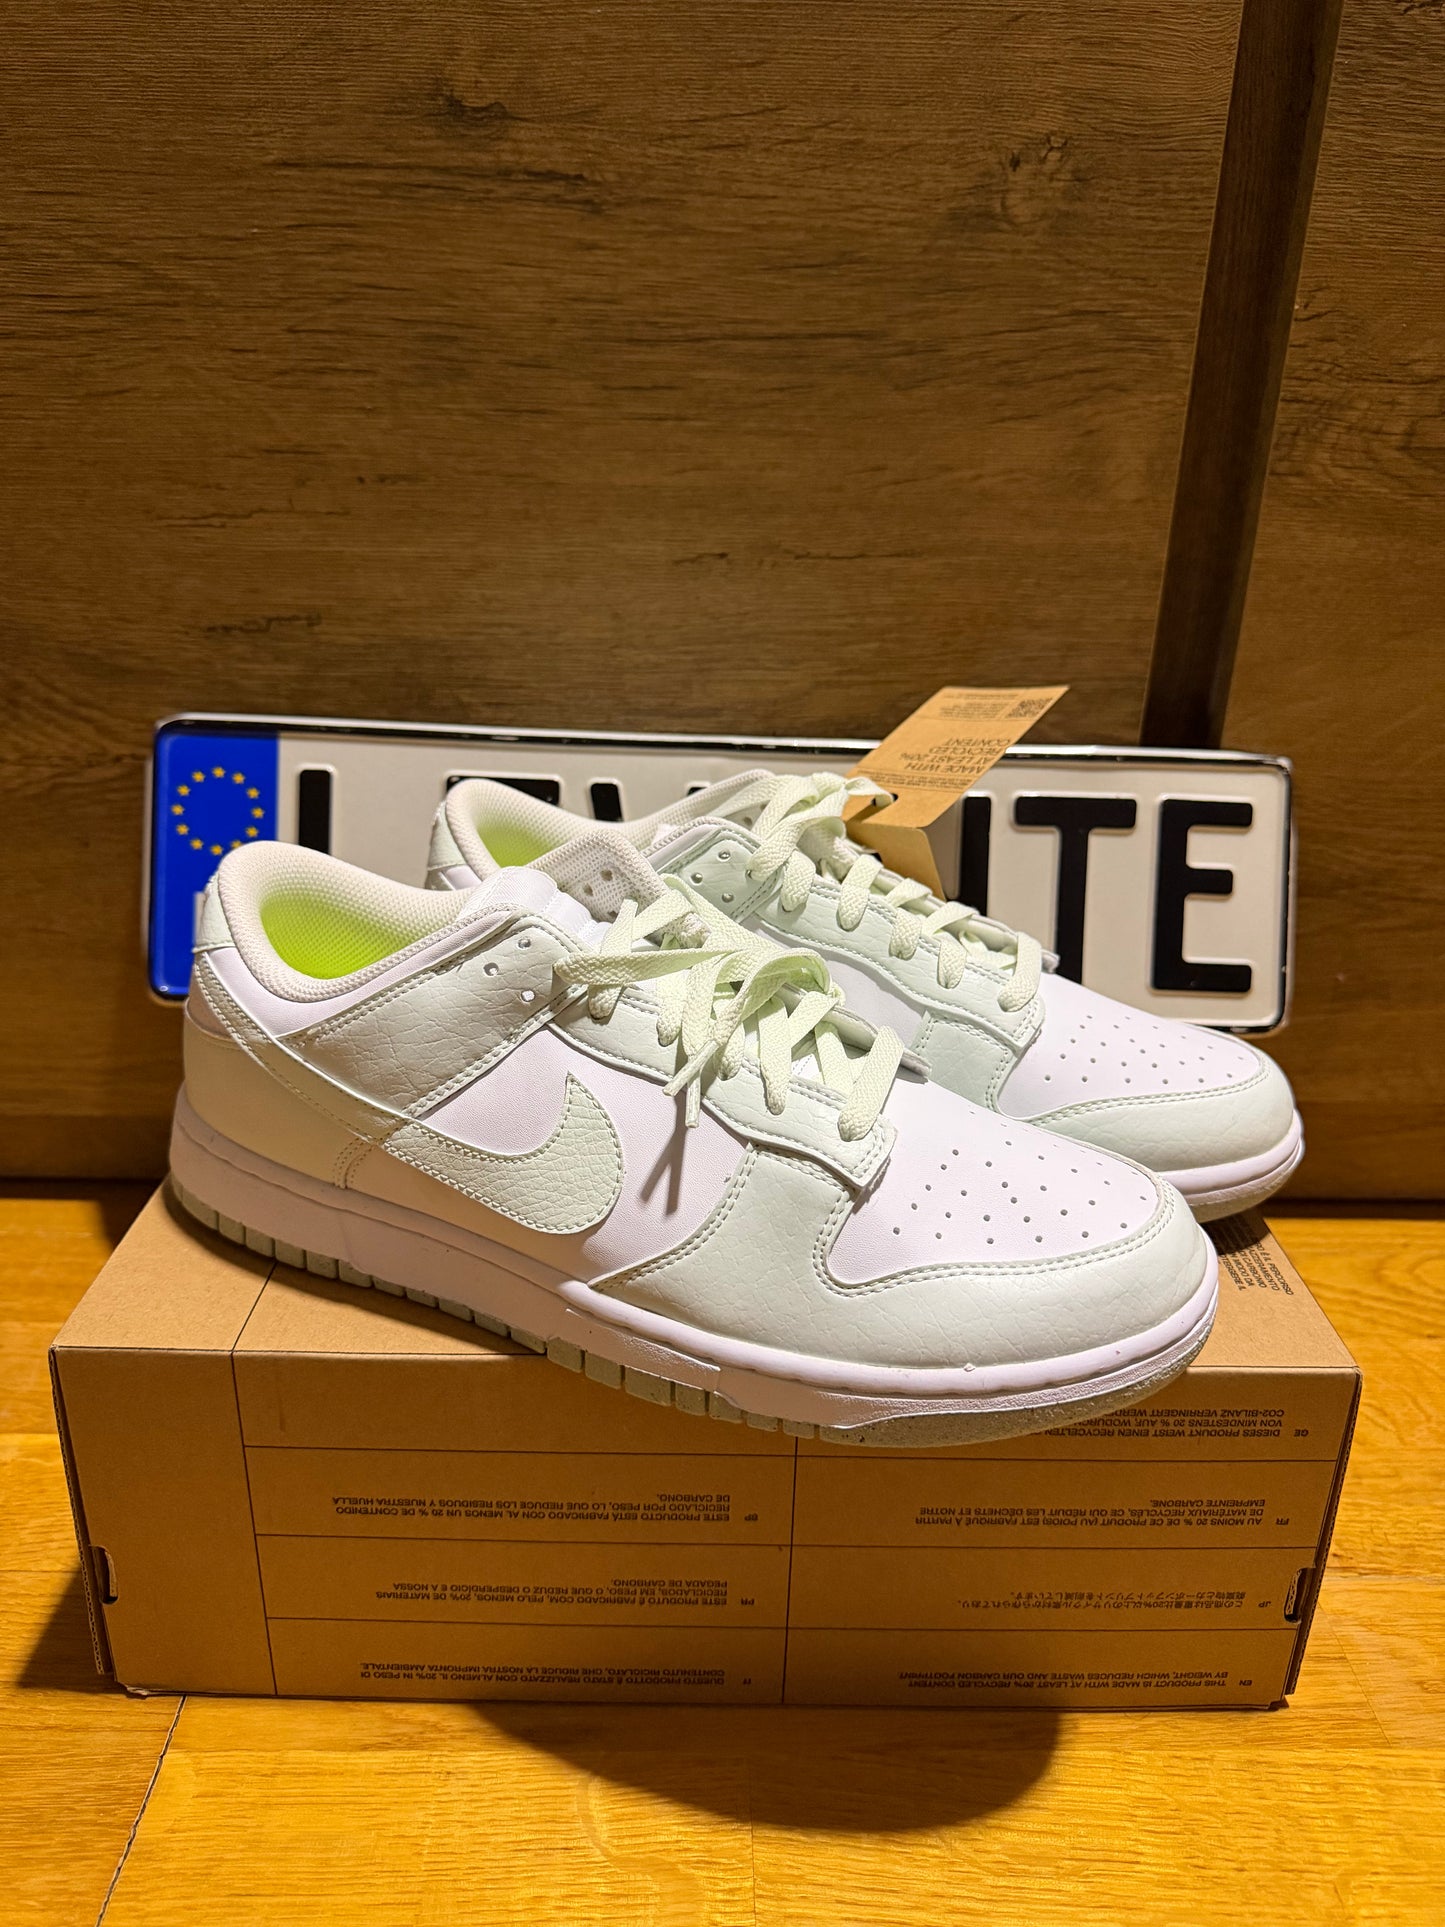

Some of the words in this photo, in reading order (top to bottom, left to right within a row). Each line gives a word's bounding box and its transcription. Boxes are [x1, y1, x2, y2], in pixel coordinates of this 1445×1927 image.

[1151, 1409, 1217, 1417] VERRINGERT
[1221, 1409, 1284, 1417] CO2-BILANZ
[1134, 1418, 1157, 1427] AUF,
[1188, 1419, 1257, 1427] MINDESTENS
[1260, 1419, 1282, 1427] VON
[332, 1496, 374, 1505] HUELLA
[376, 1497, 427, 1506] NUESTRA
[657, 1493, 713, 1502] CARBONO.
[439, 1498, 493, 1507] RESIDUOS
[496, 1499, 518, 1507] LOS
[520, 1500, 564, 1508] REDUCE
[567, 1501, 589, 1509] QUE
[644, 1502, 666, 1510] POR
[669, 1502, 730, 1511] RECICLADO
[1150, 1500, 1203, 1508] CARBONE.
[1206, 1500, 1265, 1508] EMPREINTE
[336, 1506, 399, 1515] CONTENIDO
[465, 1509, 504, 1517] MENOS
[522, 1510, 546, 1518] CON
[548, 1510, 610, 1519] FABRICADO
[920, 1507, 956, 1515] NOTRE
[974, 1508, 1024, 1517] DÉCHETS
[1026, 1508, 1045, 1516] LES
[1050, 1508, 1086, 1517] RÉDUIT
[1089, 1508, 1108, 1516] QUI
[1127, 1507, 1185, 1517] RECYCLÉS,
[1187, 1508, 1247, 1518] MATÉRIAUX
[612, 1511, 638, 1521] ESTÁ
[641, 1512, 701, 1521] PRODUCTO
[704, 1513, 730, 1521] ESTE
[915, 1517, 952, 1525] PARTIR
[965, 1517, 1017, 1527] FABRIQUÉ
[1022, 1517, 1039, 1525] EST
[1042, 1516, 1078, 1525] POIDS)
[1080, 1516, 1098, 1525] (AU
[1102, 1518, 1147, 1526] PRODUIT
[1210, 1518, 1245, 1526] MOINS
[957, 1672, 1000, 1680] CARBON
[1051, 1671, 1085, 1679] WASTE
[1087, 1671, 1134, 1679] REDUCES
[1137, 1671, 1170, 1679] WHICH
[1172, 1670, 1213, 1679] WEIGHT,
[909, 1680, 956, 1688] CONTENT
[958, 1680, 1011, 1688] RECYCLED
[1014, 1680, 1034, 1688] 20%
[1038, 1680, 1068, 1688] LEAST
[1084, 1680, 1109, 1688] WITH
[1112, 1680, 1140, 1688] MADE
[1155, 1680, 1201, 1688] PRODUCT
[1203, 1680, 1226, 1688] THIS
